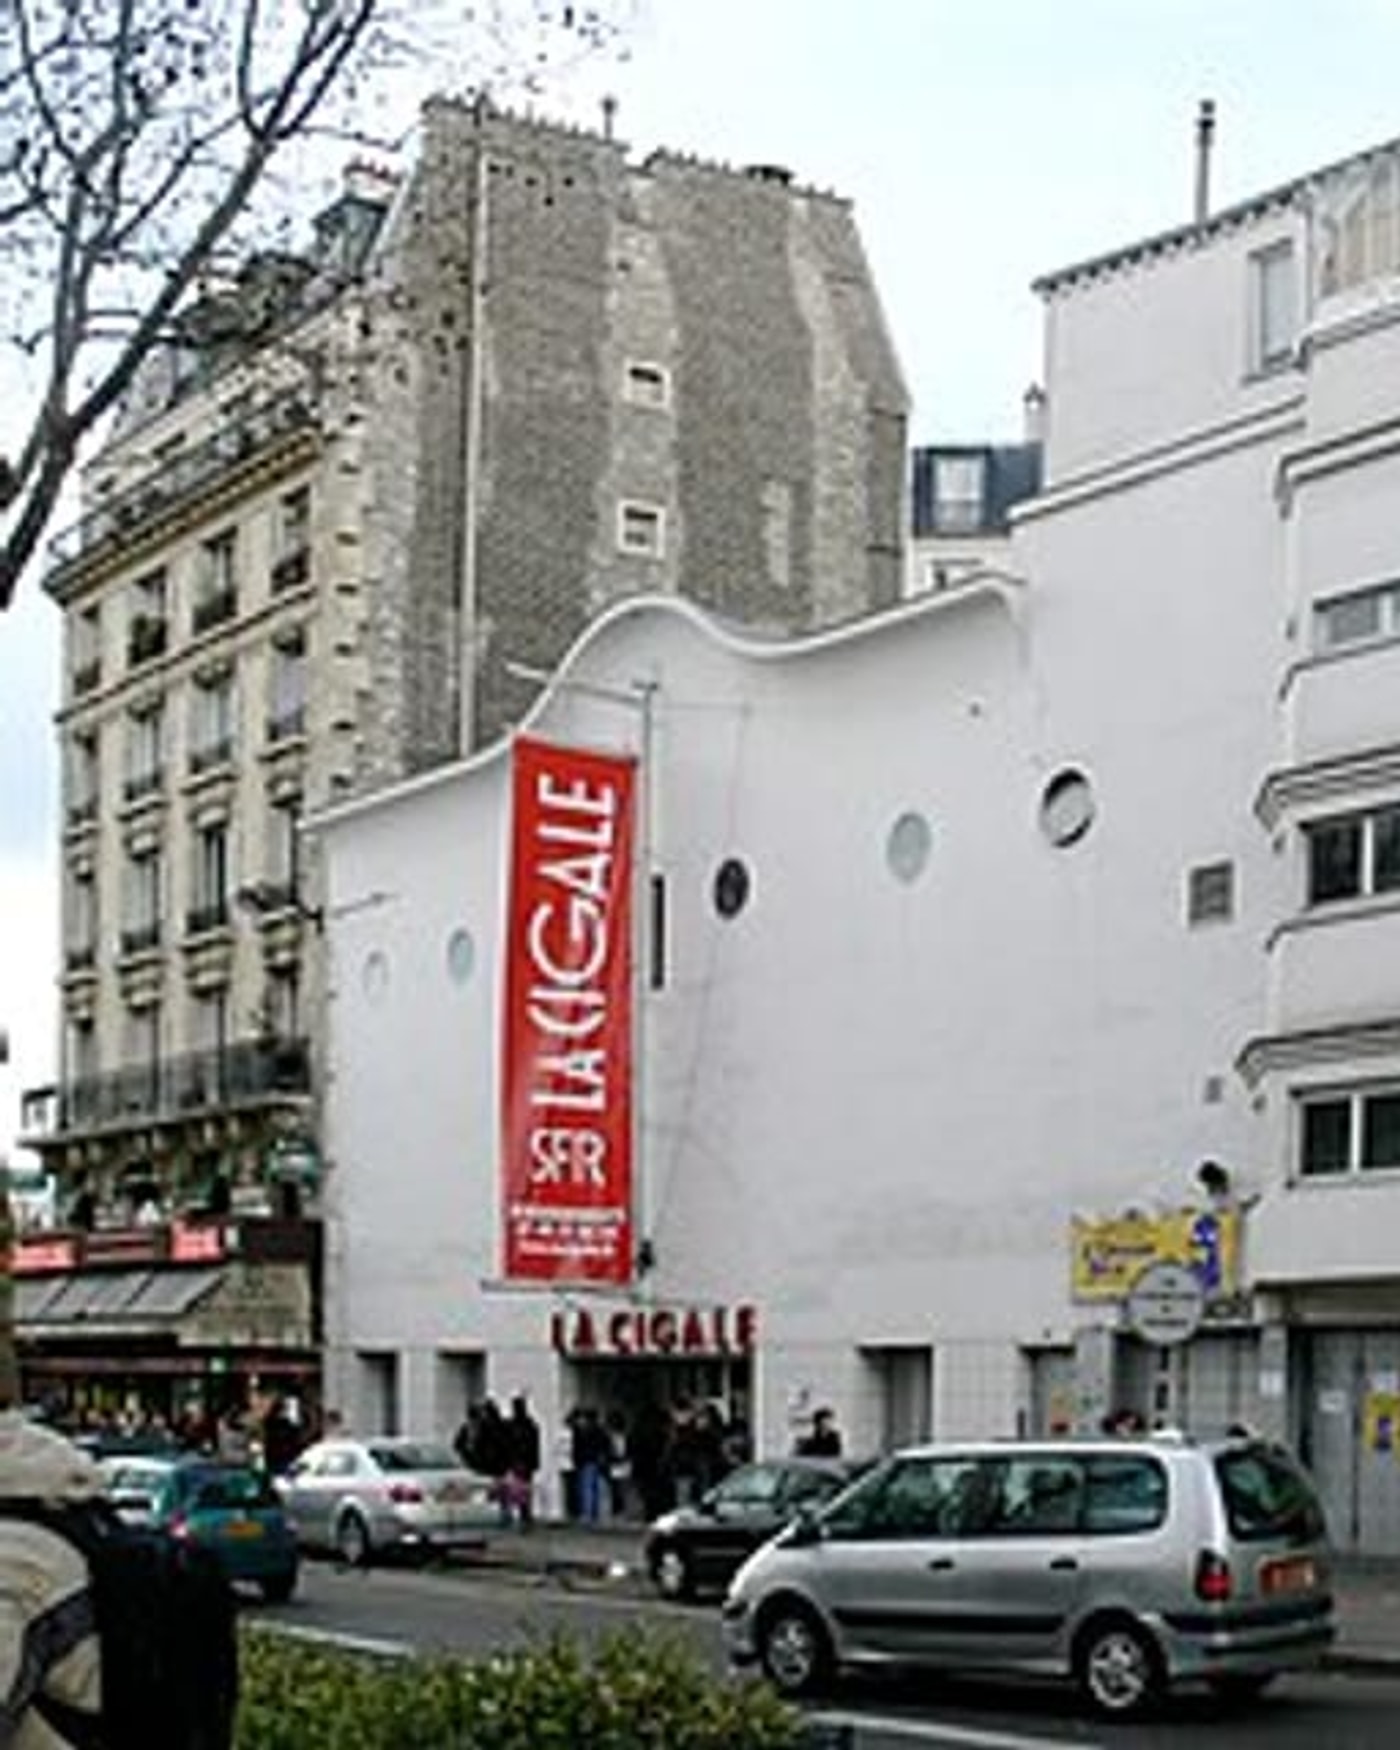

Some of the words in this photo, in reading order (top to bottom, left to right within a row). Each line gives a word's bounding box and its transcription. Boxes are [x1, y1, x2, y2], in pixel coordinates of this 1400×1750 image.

[526, 773, 614, 1037] CIGALE
[530, 1048, 606, 1111] LA
[551, 1306, 597, 1354] LA
[609, 1304, 757, 1354] CIGALE
